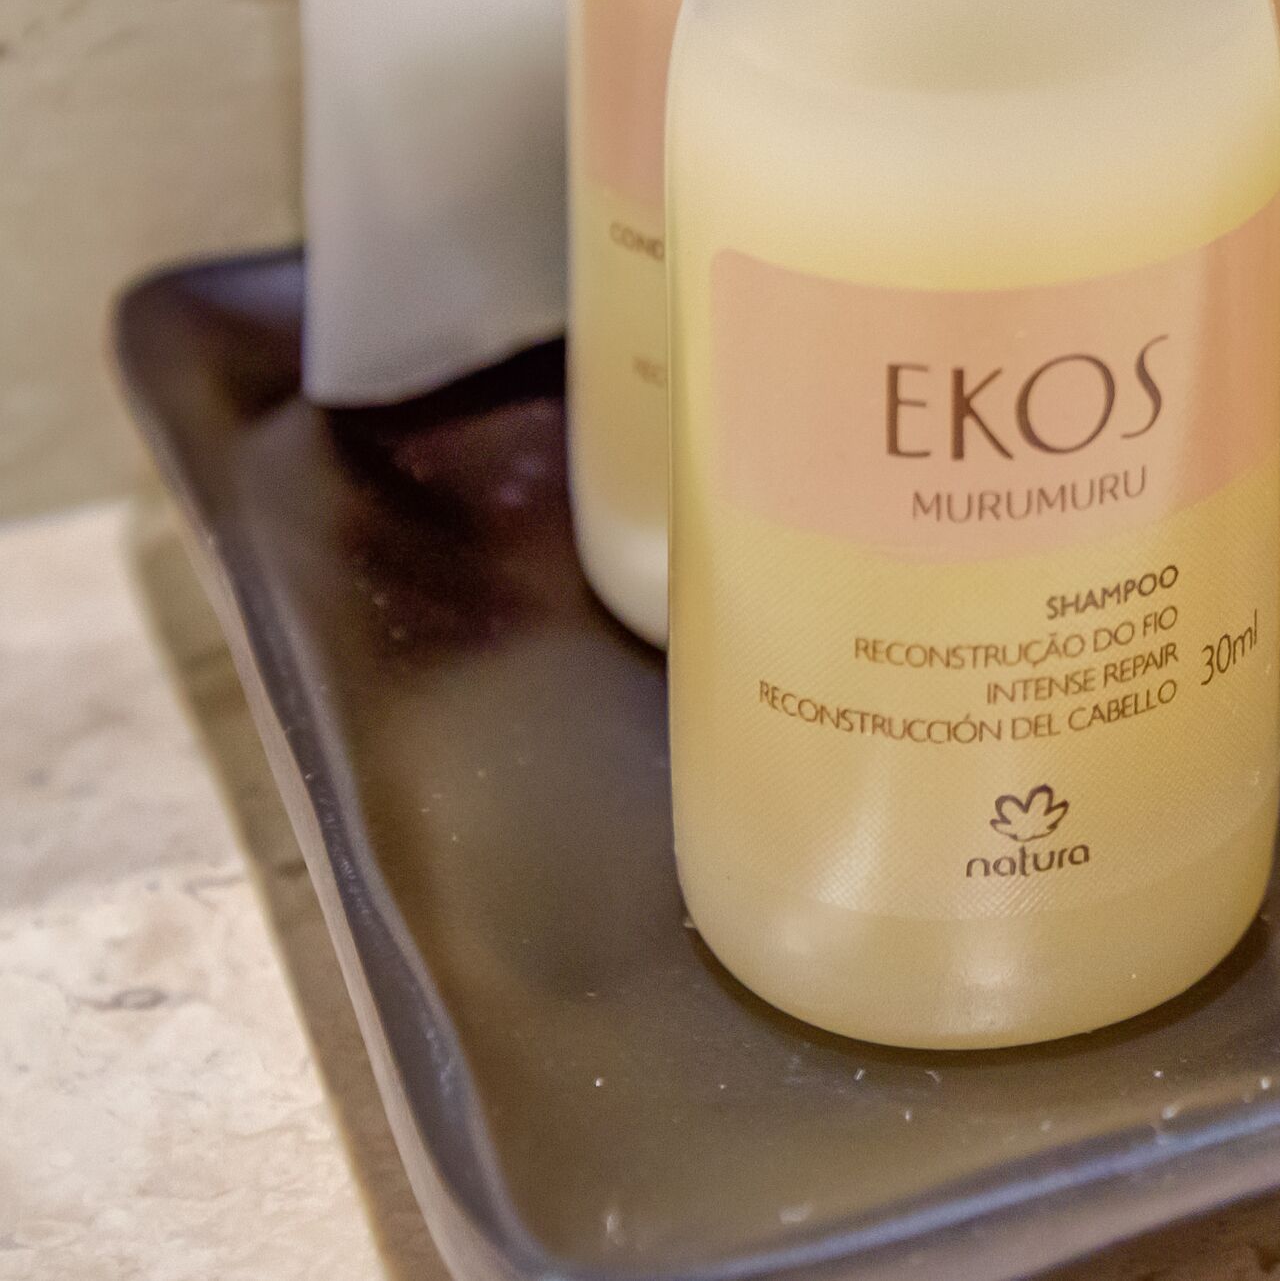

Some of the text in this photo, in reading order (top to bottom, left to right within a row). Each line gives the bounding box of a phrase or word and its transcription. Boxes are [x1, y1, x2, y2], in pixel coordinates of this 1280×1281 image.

[886, 334, 1169, 460] EKOS
[911, 466, 1147, 523] MURUMURU
[1046, 565, 1179, 619] SHAMPOO
[854, 605, 1178, 669] RECONSTRUÇÃO DO FIO
[1200, 608, 1258, 686] 30ml
[986, 642, 1178, 705] INTENSE REPAIR
[758, 679, 1178, 744] RECONSTRUCCIÓN DEL CABELLO
[966, 844, 1090, 878] natura
